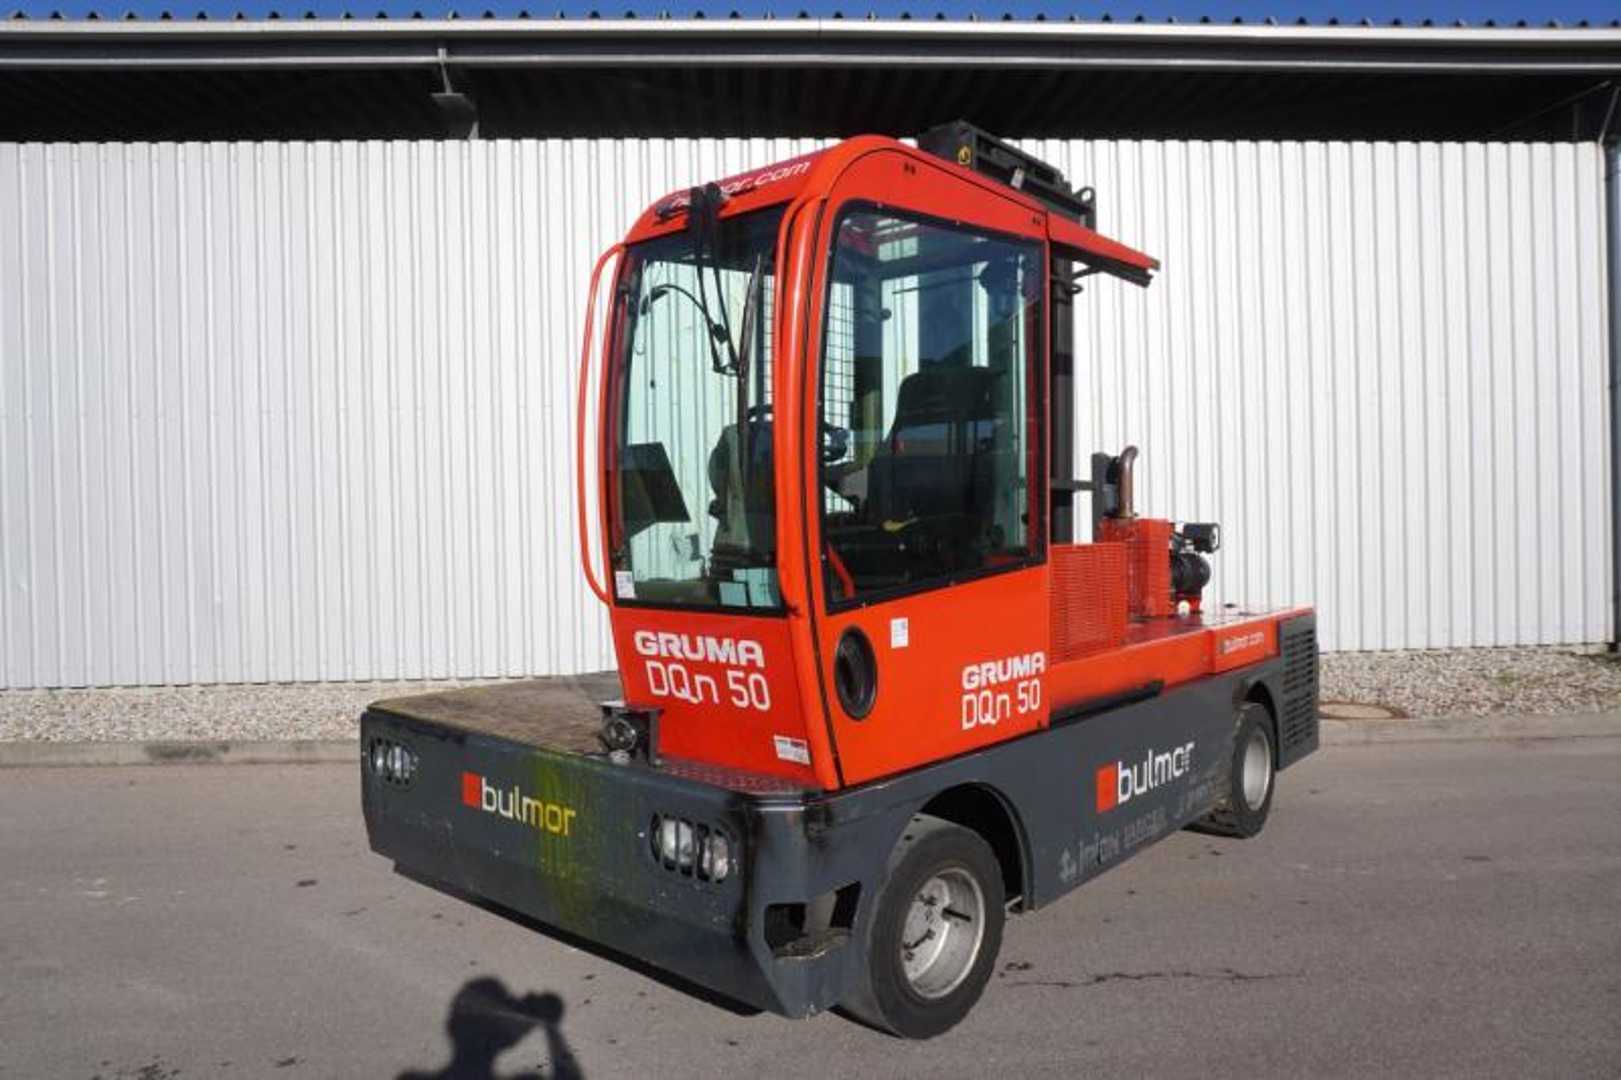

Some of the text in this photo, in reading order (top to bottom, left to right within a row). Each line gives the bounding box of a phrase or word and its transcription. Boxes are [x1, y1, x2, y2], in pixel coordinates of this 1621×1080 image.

[633, 630, 766, 669] GRUMA
[961, 651, 1046, 690] GRUMA
[645, 659, 772, 711] DQn 50
[961, 678, 1041, 731] DQn 50
[1117, 741, 1195, 805] bulmor
[481, 776, 576, 836] bulmor
